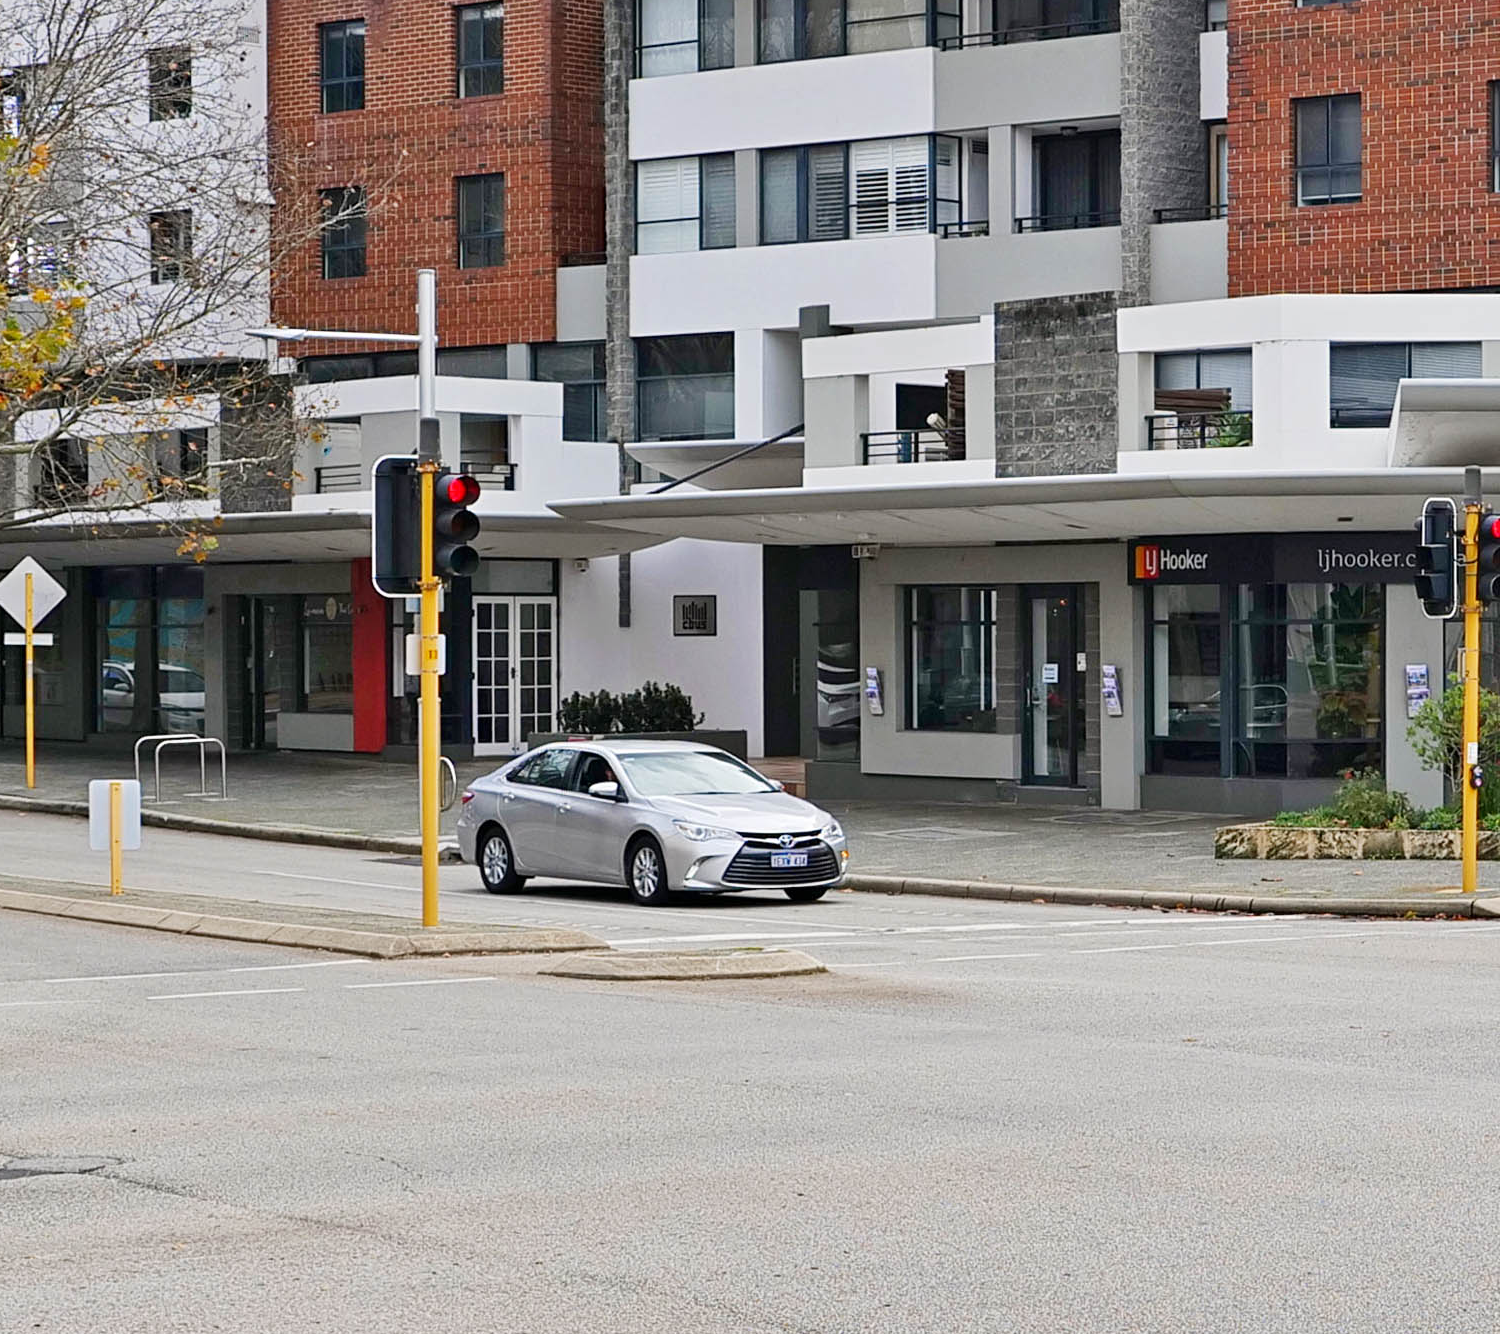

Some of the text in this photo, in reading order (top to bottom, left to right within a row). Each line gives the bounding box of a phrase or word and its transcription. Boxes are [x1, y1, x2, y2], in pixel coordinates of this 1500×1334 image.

[1146, 549, 1208, 576] LJ Hooker
[1318, 549, 1477, 572] ljhooker.ca
